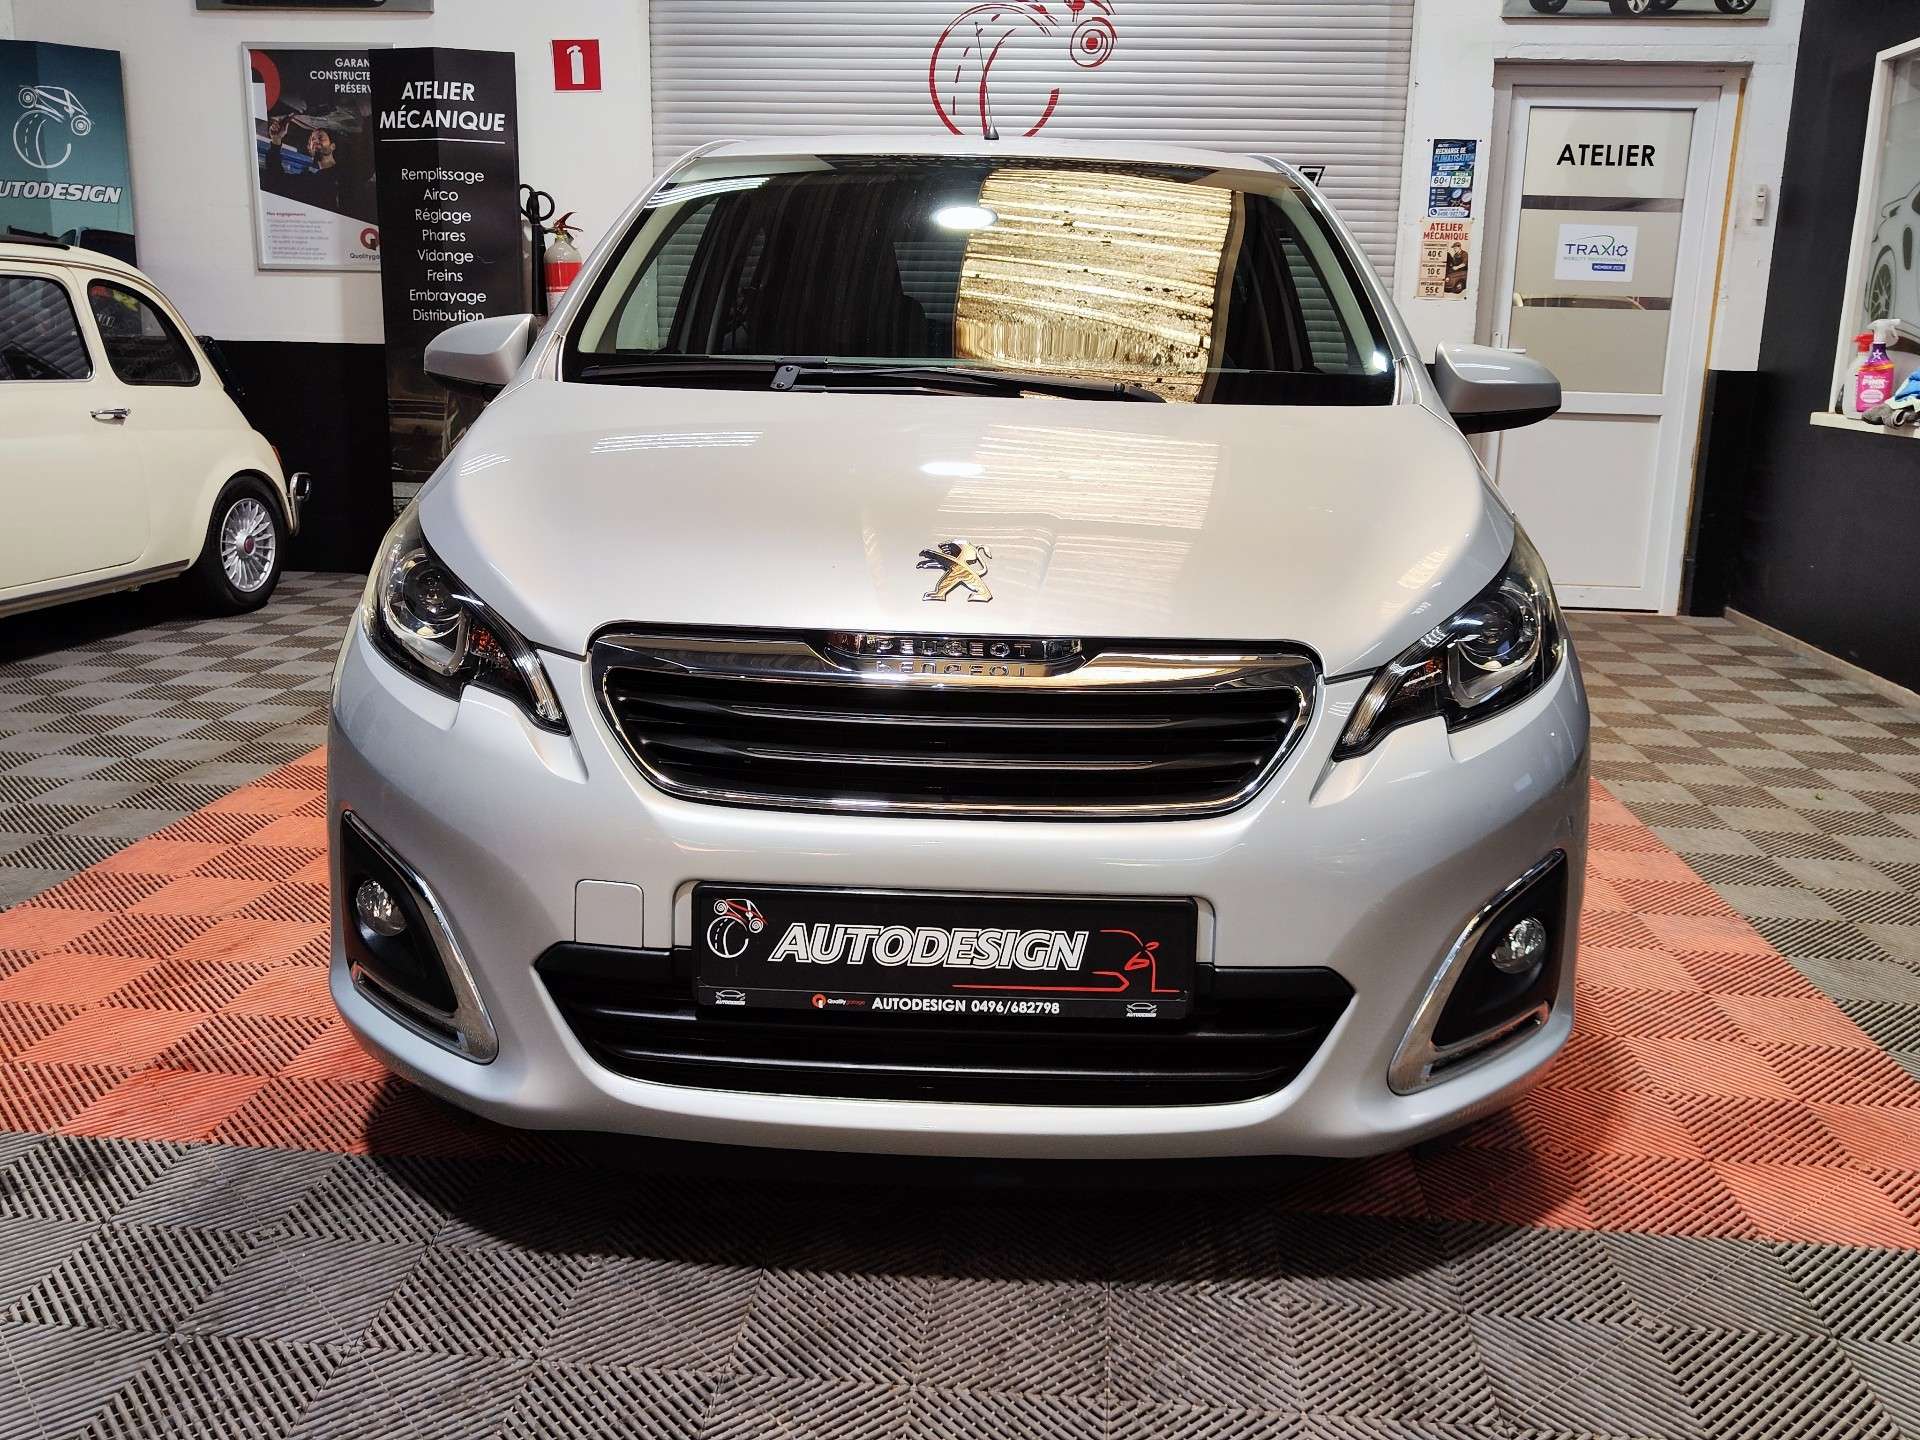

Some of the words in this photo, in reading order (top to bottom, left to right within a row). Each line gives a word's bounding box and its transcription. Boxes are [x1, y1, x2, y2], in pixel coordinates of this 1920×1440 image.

[309, 70, 371, 81] CONSTRUCTE
[401, 80, 475, 101] ATELIER
[379, 104, 506, 132] MÉCANIQUE
[1556, 143, 1656, 167] ATELIER
[401, 167, 485, 185] Remplissage
[423, 187, 459, 202] Airco
[415, 207, 472, 225] Réglage
[1430, 222, 1464, 231] ATELIER
[422, 228, 467, 242] Phares
[1423, 231, 1469, 241] MÉCANIQUE
[417, 248, 474, 265] Vidange
[1564, 242, 1629, 257] TRAXIO
[427, 268, 464, 282] Freins
[409, 289, 487, 305] Embrayage
[412, 308, 486, 322] Distribution
[876, 639, 1032, 657] PEUGEOT
[767, 922, 1090, 971] AUTODESIGN
[872, 997, 966, 1012] AUTODESIGN
[970, 1000, 1060, 1015] 0496/682798
